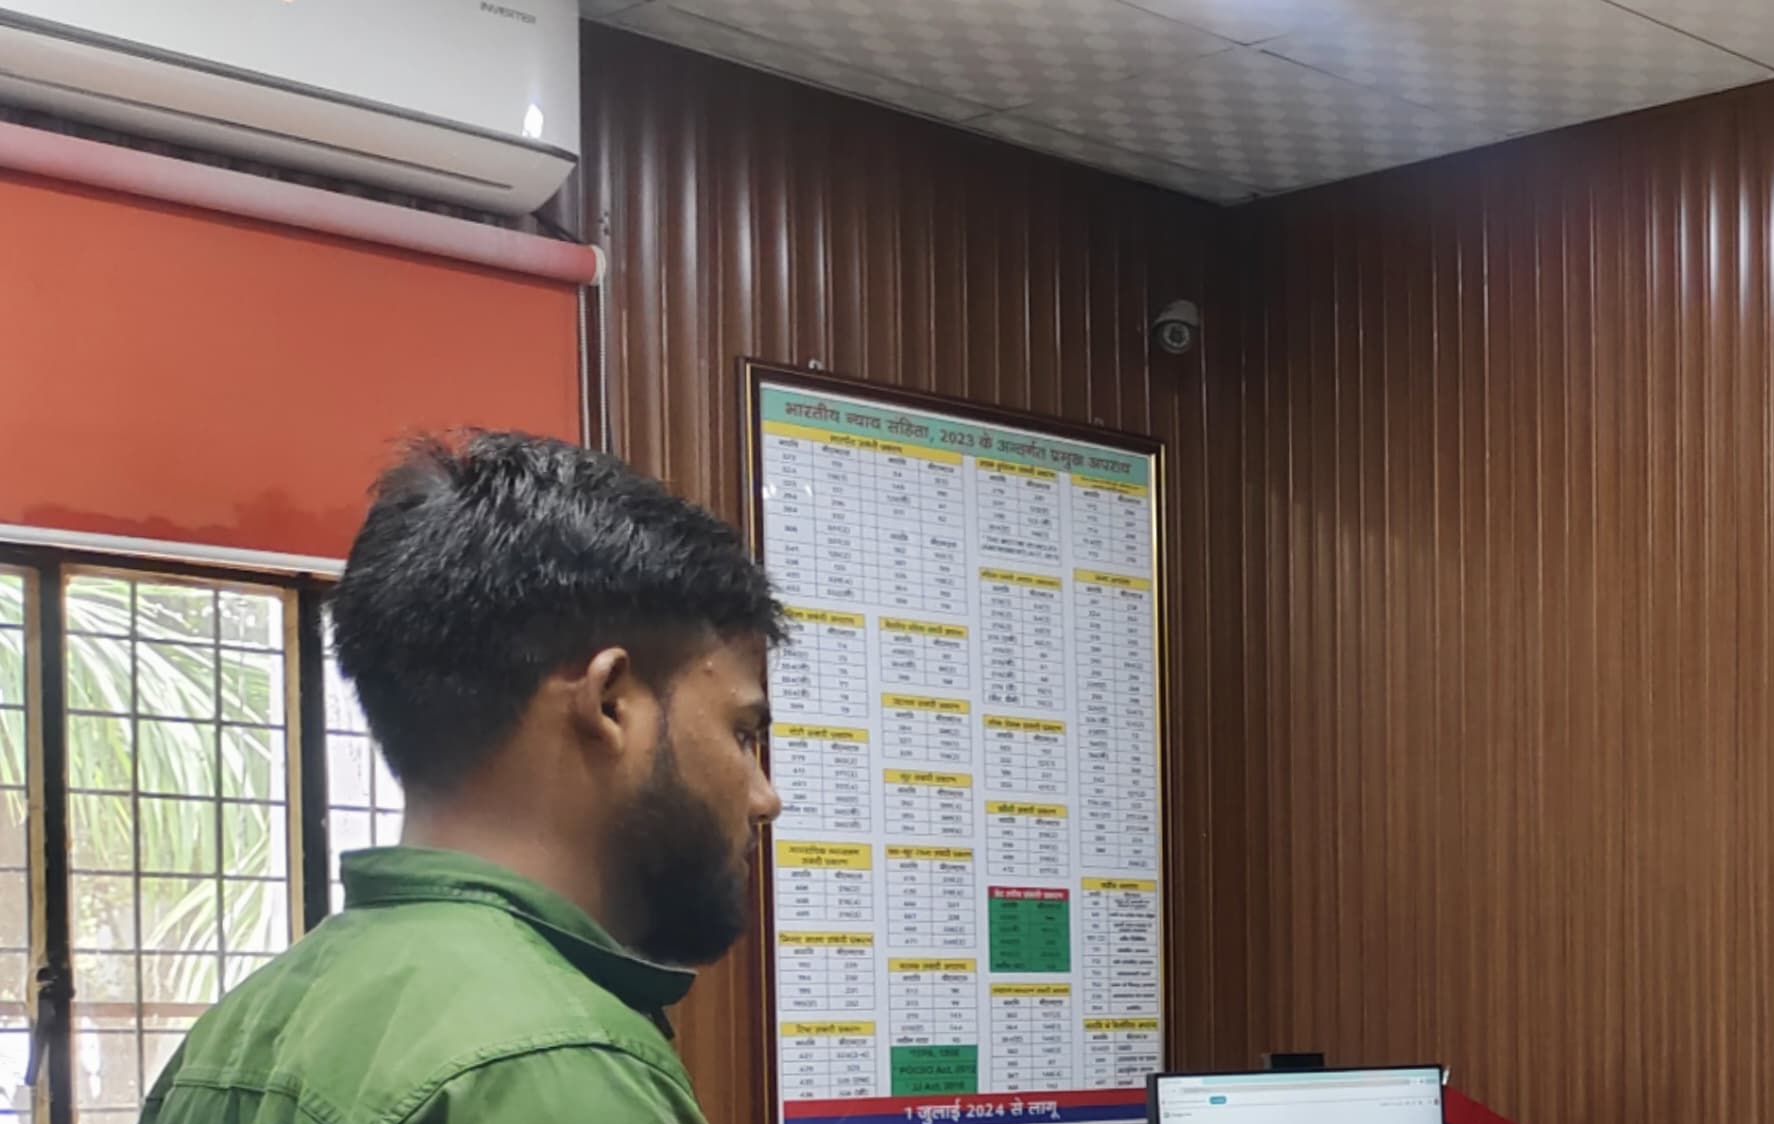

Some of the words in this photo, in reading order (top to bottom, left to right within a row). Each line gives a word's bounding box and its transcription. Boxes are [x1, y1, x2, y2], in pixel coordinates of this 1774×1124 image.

[480, 1, 537, 25] INVERTER
[784, 401, 841, 424] भारतीय
[939, 428, 975, 447] 2023
[978, 432, 994, 449] के
[904, 1106, 913, 1120] 1
[965, 1103, 1005, 1119] 2024
[1010, 1097, 1024, 1116] से
[1028, 1100, 1061, 1120] लागू
